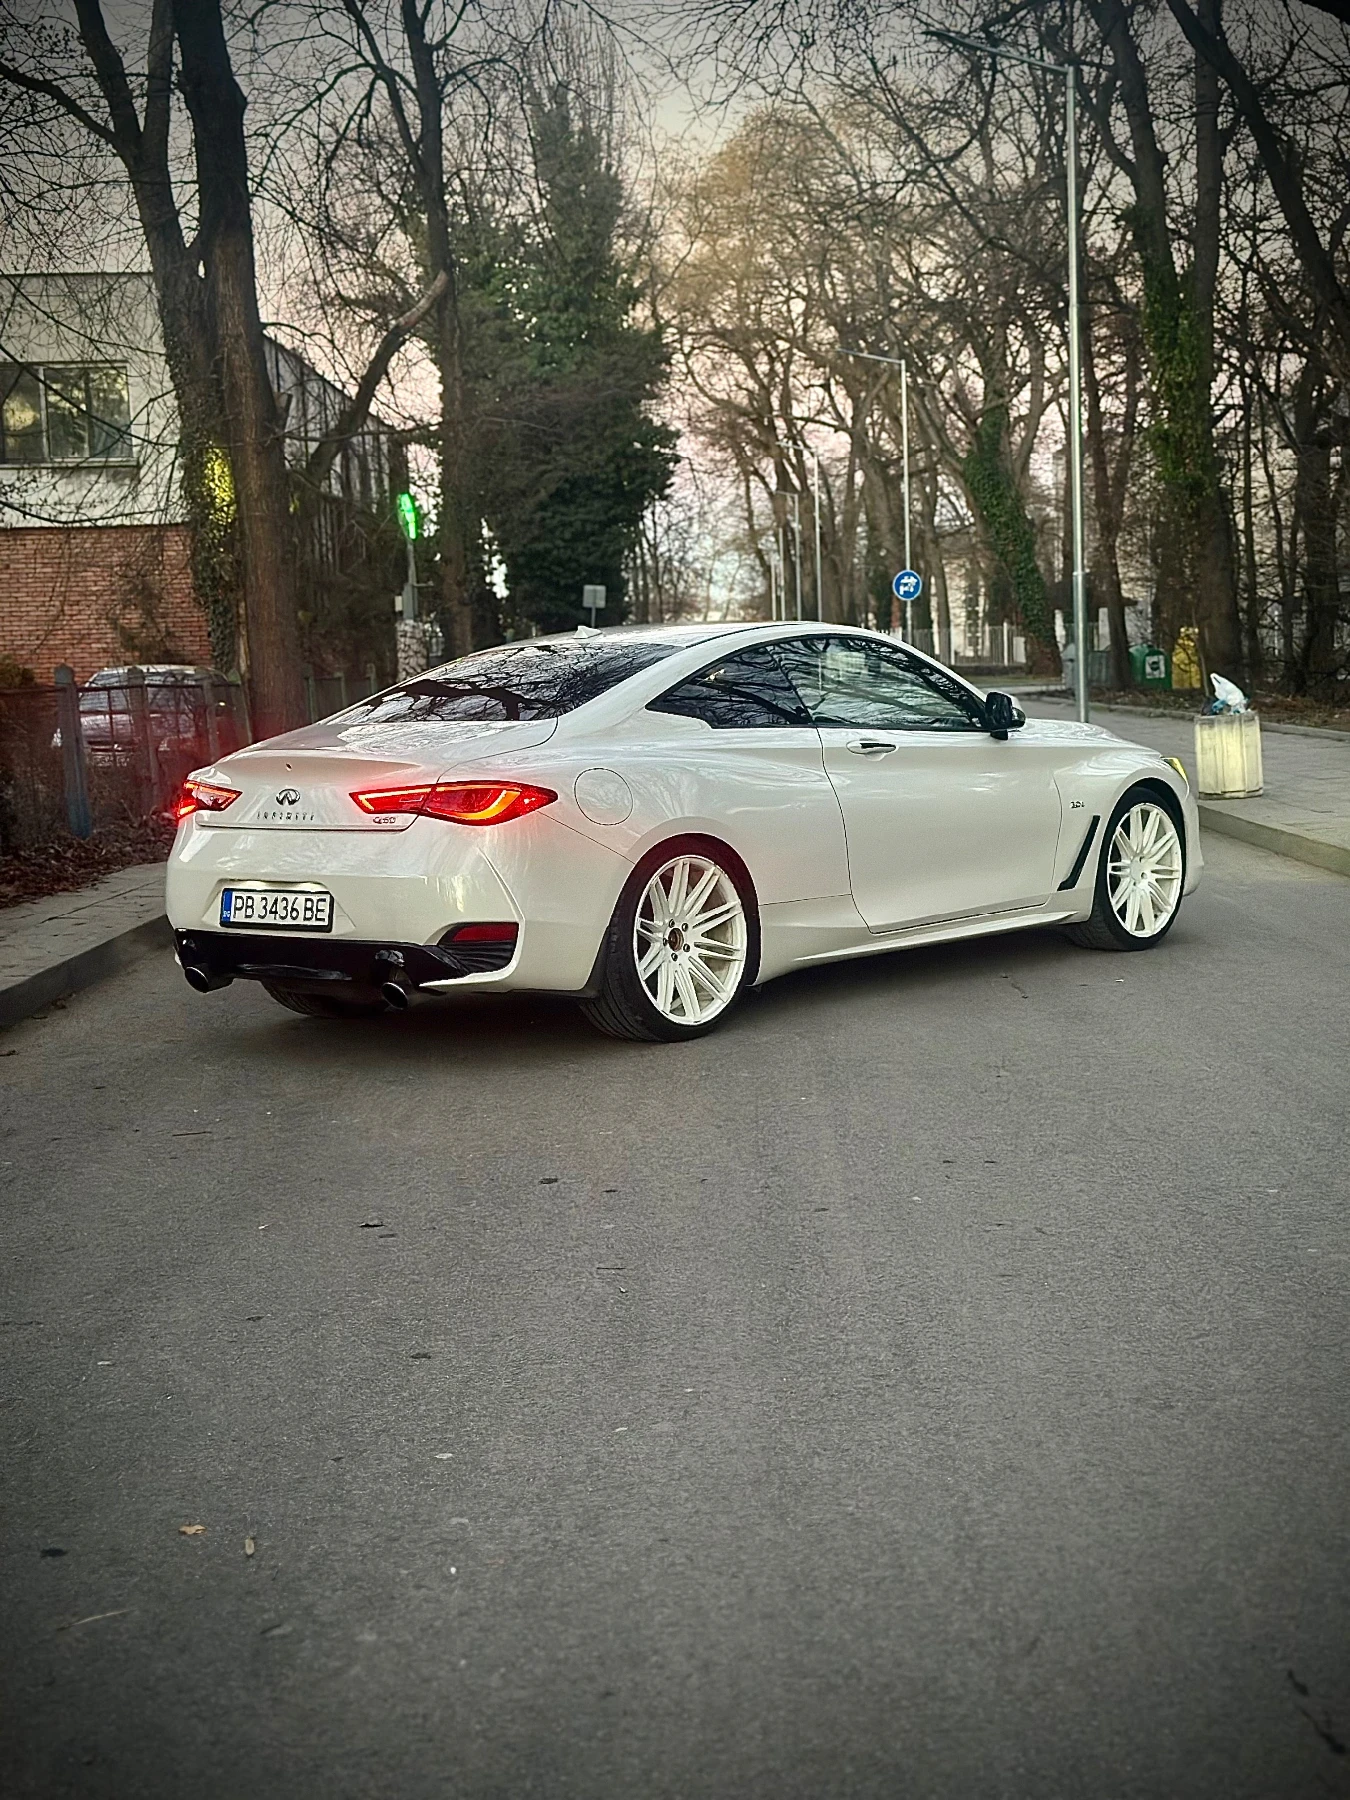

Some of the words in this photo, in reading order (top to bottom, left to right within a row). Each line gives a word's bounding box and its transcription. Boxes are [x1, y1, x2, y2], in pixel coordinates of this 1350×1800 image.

[233, 895, 255, 919] PB
[258, 896, 300, 920] 3436
[303, 897, 327, 922] BE
